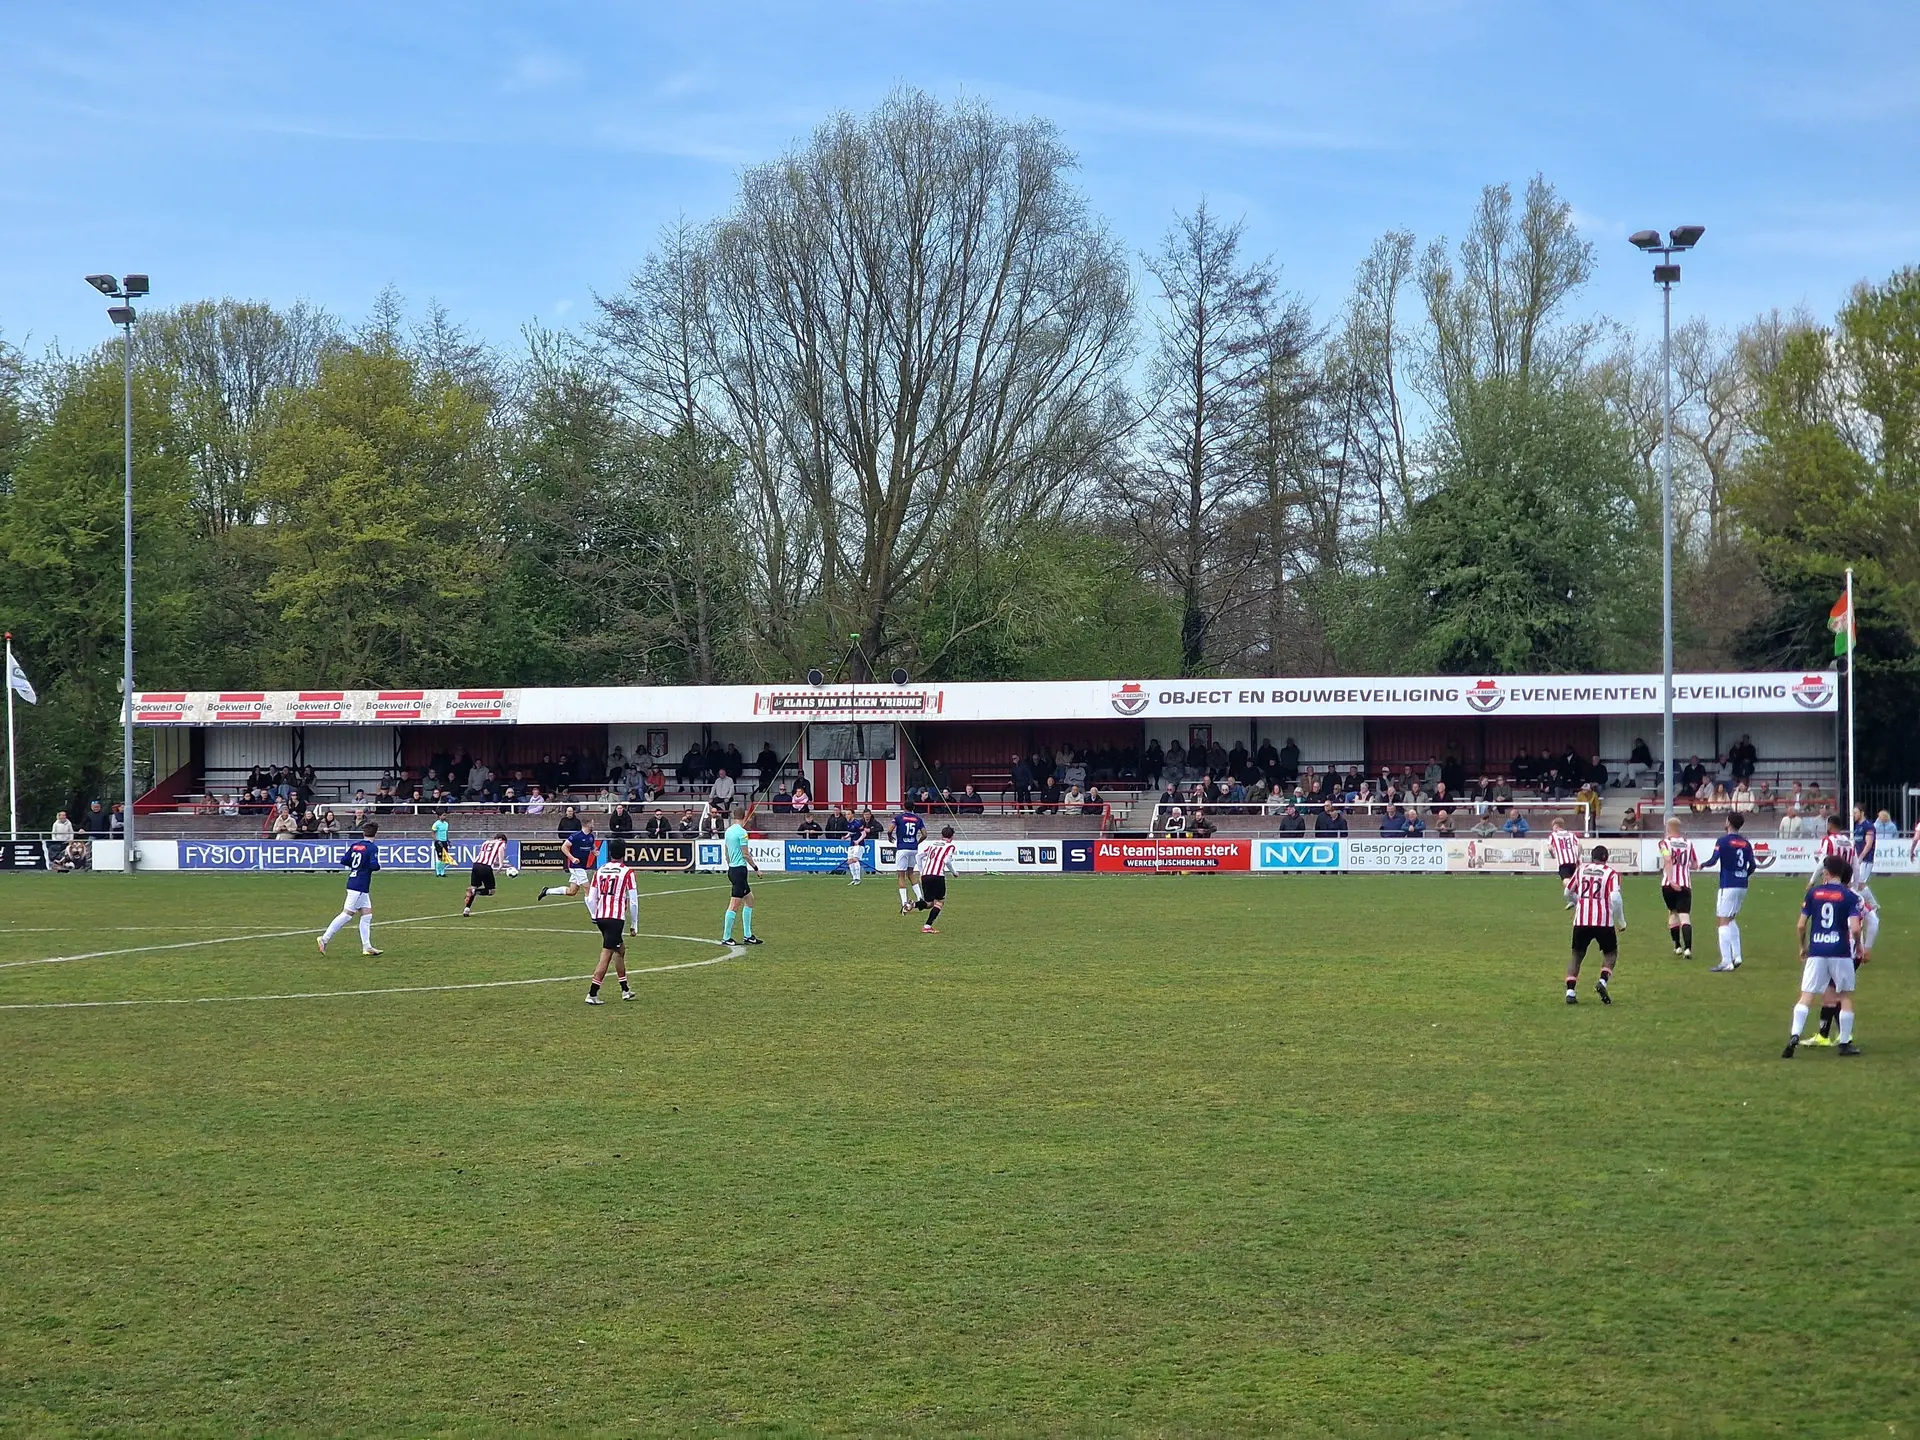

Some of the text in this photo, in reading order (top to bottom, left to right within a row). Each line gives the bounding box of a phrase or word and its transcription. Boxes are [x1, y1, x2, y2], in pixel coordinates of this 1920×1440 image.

[1159, 689, 1459, 704] OBJECT EN BOUWBEVEILIGING
[1511, 688, 1657, 701] EVENEMENTEN
[175, 703, 194, 711] Olie
[207, 702, 272, 711] Boekweit Olie
[286, 702, 352, 711] Boekweit Olie
[366, 701, 432, 710] Boekweit Olie
[446, 700, 512, 709] Boekweit Olie
[783, 698, 815, 708] KLAAS
[818, 698, 837, 707] VAN
[839, 697, 878, 707] KALKEN
[880, 696, 921, 707] TRIBUNE
[904, 822, 916, 836] 15
[186, 846, 346, 864] FYSIOTHERAPIE
[624, 848, 687, 862] RAVEL
[702, 847, 719, 863] H
[788, 844, 822, 855] Woning
[1041, 850, 1056, 861] DW
[1070, 848, 1086, 862] S
[1099, 843, 1239, 857] Als team samen sterk
[1265, 846, 1334, 863] NVD
[1350, 843, 1443, 855] Glasprojecten
[1127, 859, 1217, 867] WERKENBIJSCHERMER.NL
[1350, 856, 1365, 865] 06
[1376, 856, 1390, 865] 30
[1394, 856, 1407, 865] 73
[1410, 856, 1425, 865] 22
[1428, 856, 1442, 865] 40
[1736, 848, 1745, 868] 3
[600, 878, 616, 896] 11
[1581, 880, 1602, 899] 22
[1821, 902, 1834, 928] 9
